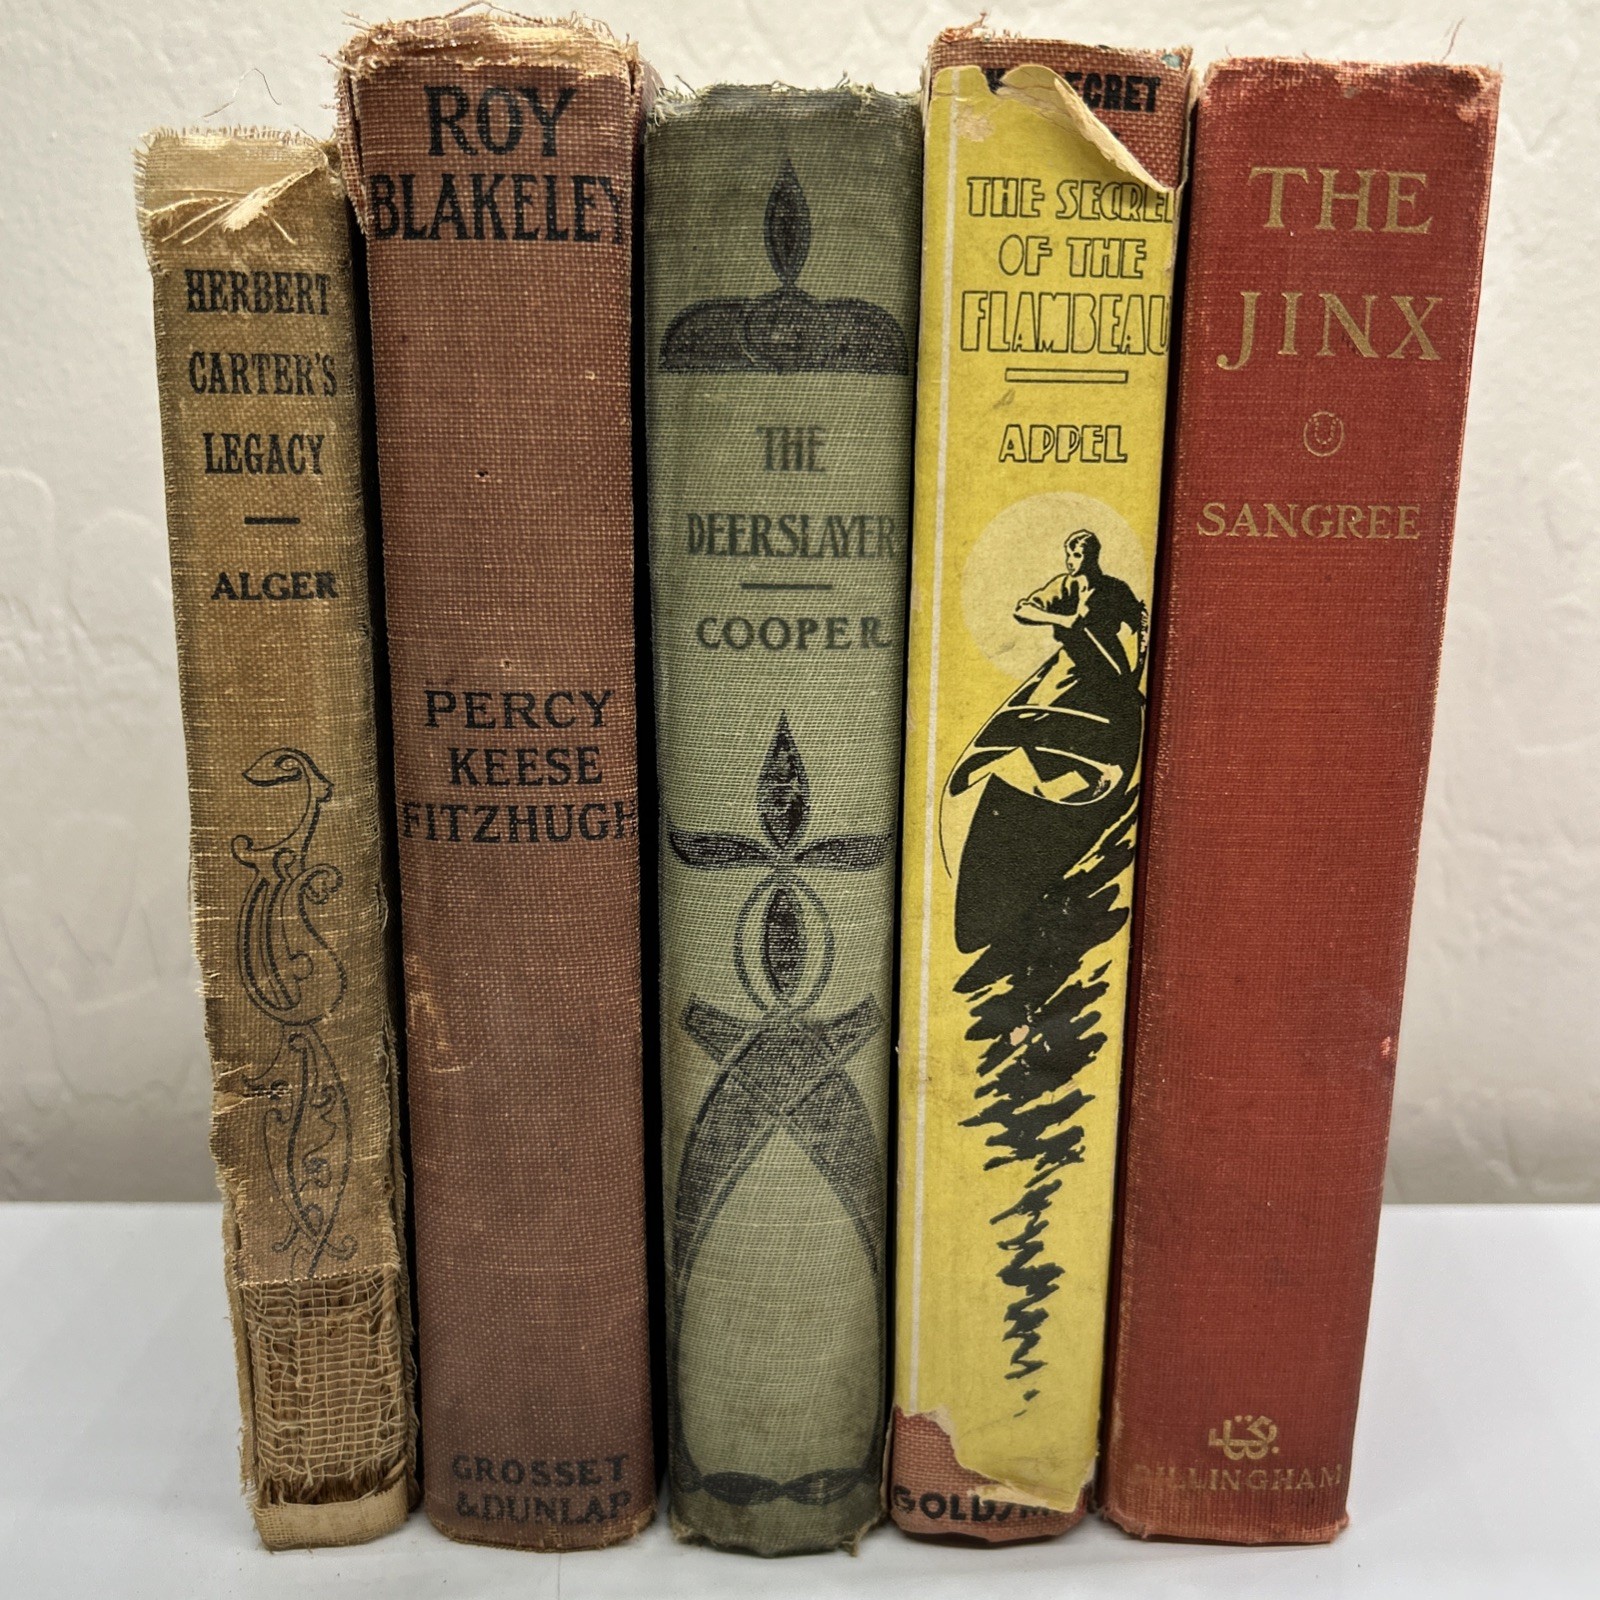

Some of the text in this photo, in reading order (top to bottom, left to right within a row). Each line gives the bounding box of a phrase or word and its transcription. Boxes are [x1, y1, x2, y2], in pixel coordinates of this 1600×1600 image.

[1064, 71, 1161, 113] ECRET
[424, 85, 579, 157] ROY
[370, 173, 622, 244] BLAKELEY
[967, 176, 1045, 218] THE
[1249, 165, 1434, 235] THE
[999, 234, 1147, 279] OF THE
[184, 269, 332, 315] HERBERT
[960, 290, 1171, 356] FLAMBEAU
[1216, 291, 1443, 371] JINX
[188, 351, 338, 397] CARTER'S
[203, 432, 326, 475] LEGACY
[756, 424, 826, 472] THE
[999, 424, 1129, 464] APPEL
[687, 512, 902, 558] DEERSLAYER
[1196, 502, 1421, 541] SANGREE
[211, 571, 339, 601] ALGER
[697, 616, 893, 650] COOPER
[424, 688, 615, 729] PERCY
[447, 746, 604, 787] KEESE
[401, 800, 638, 843] FITZHUGH
[452, 1454, 630, 1487] GROSSET
